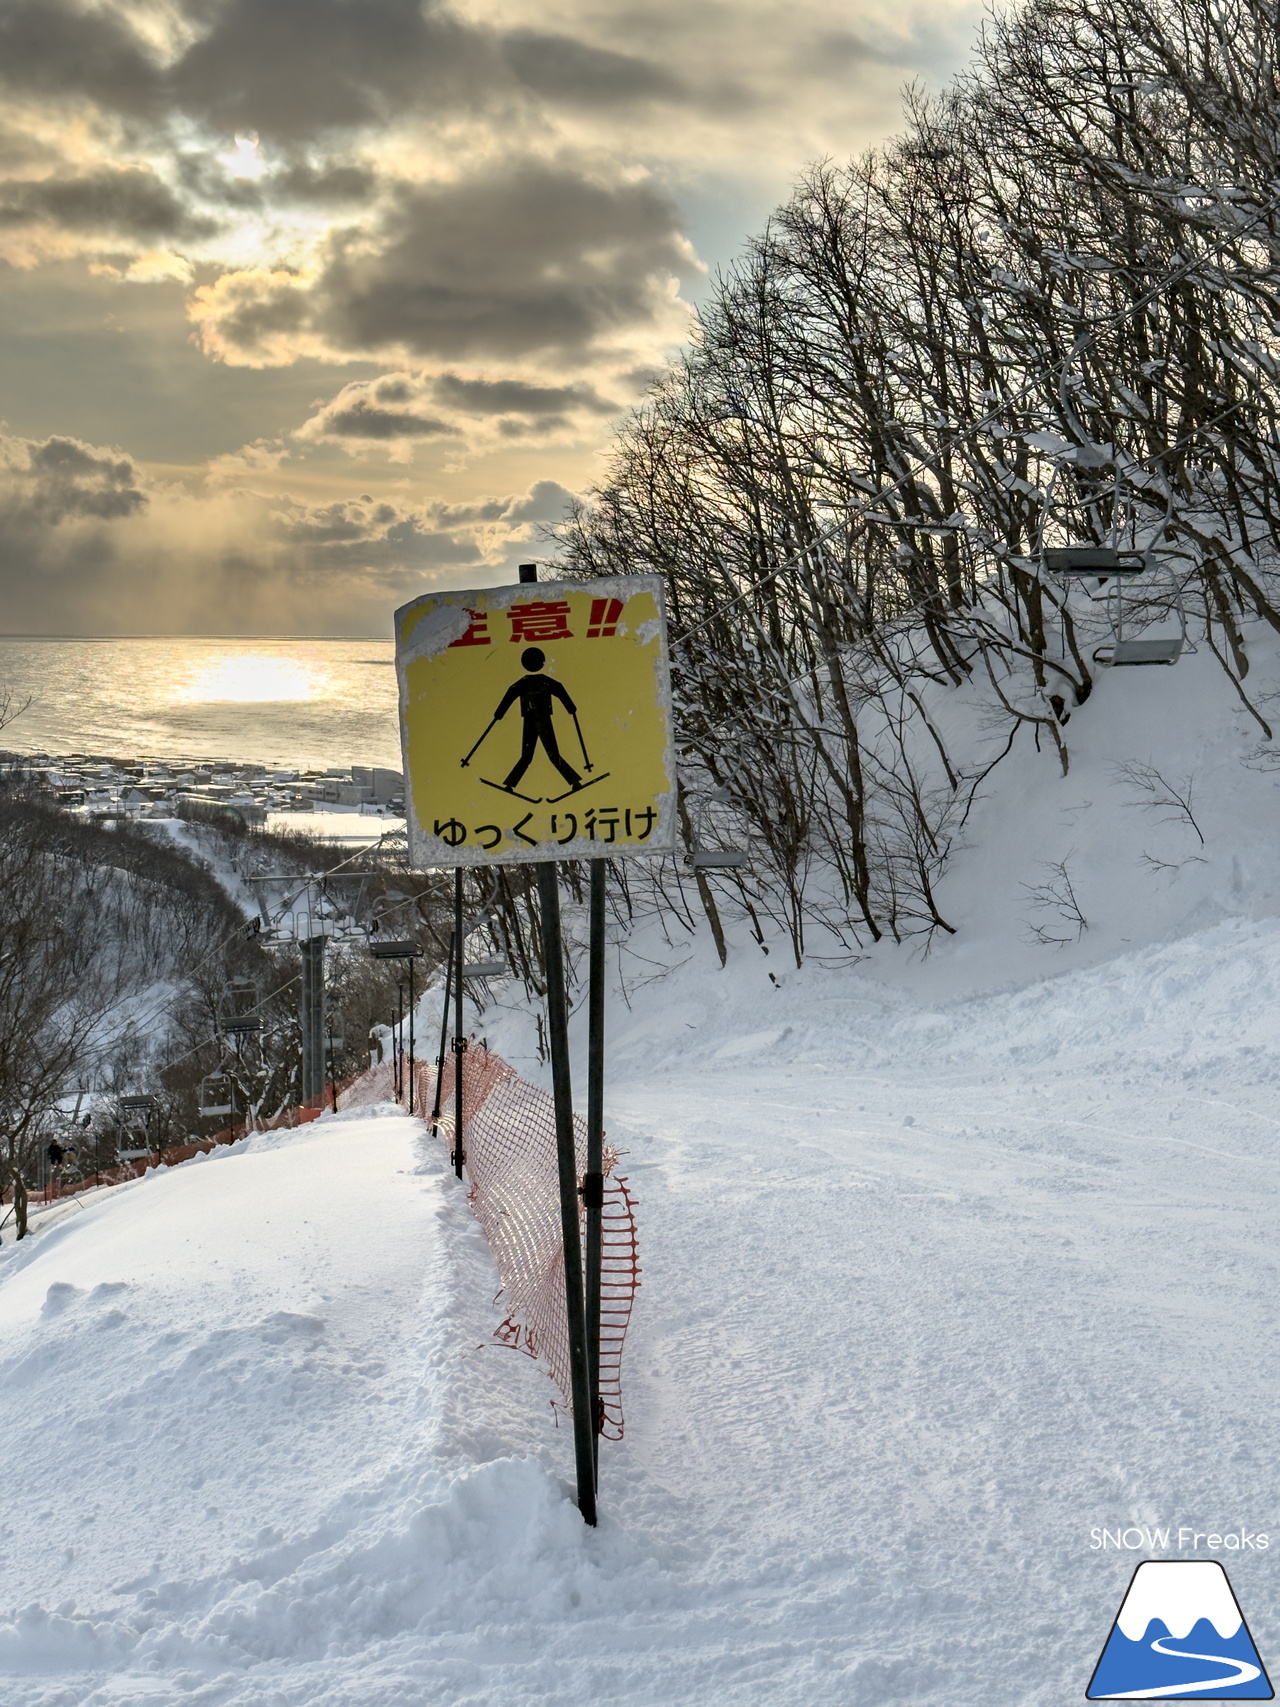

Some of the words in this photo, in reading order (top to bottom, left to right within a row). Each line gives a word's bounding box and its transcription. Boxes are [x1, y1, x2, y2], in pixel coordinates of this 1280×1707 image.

[434, 806, 657, 849] ゆっくり行け
